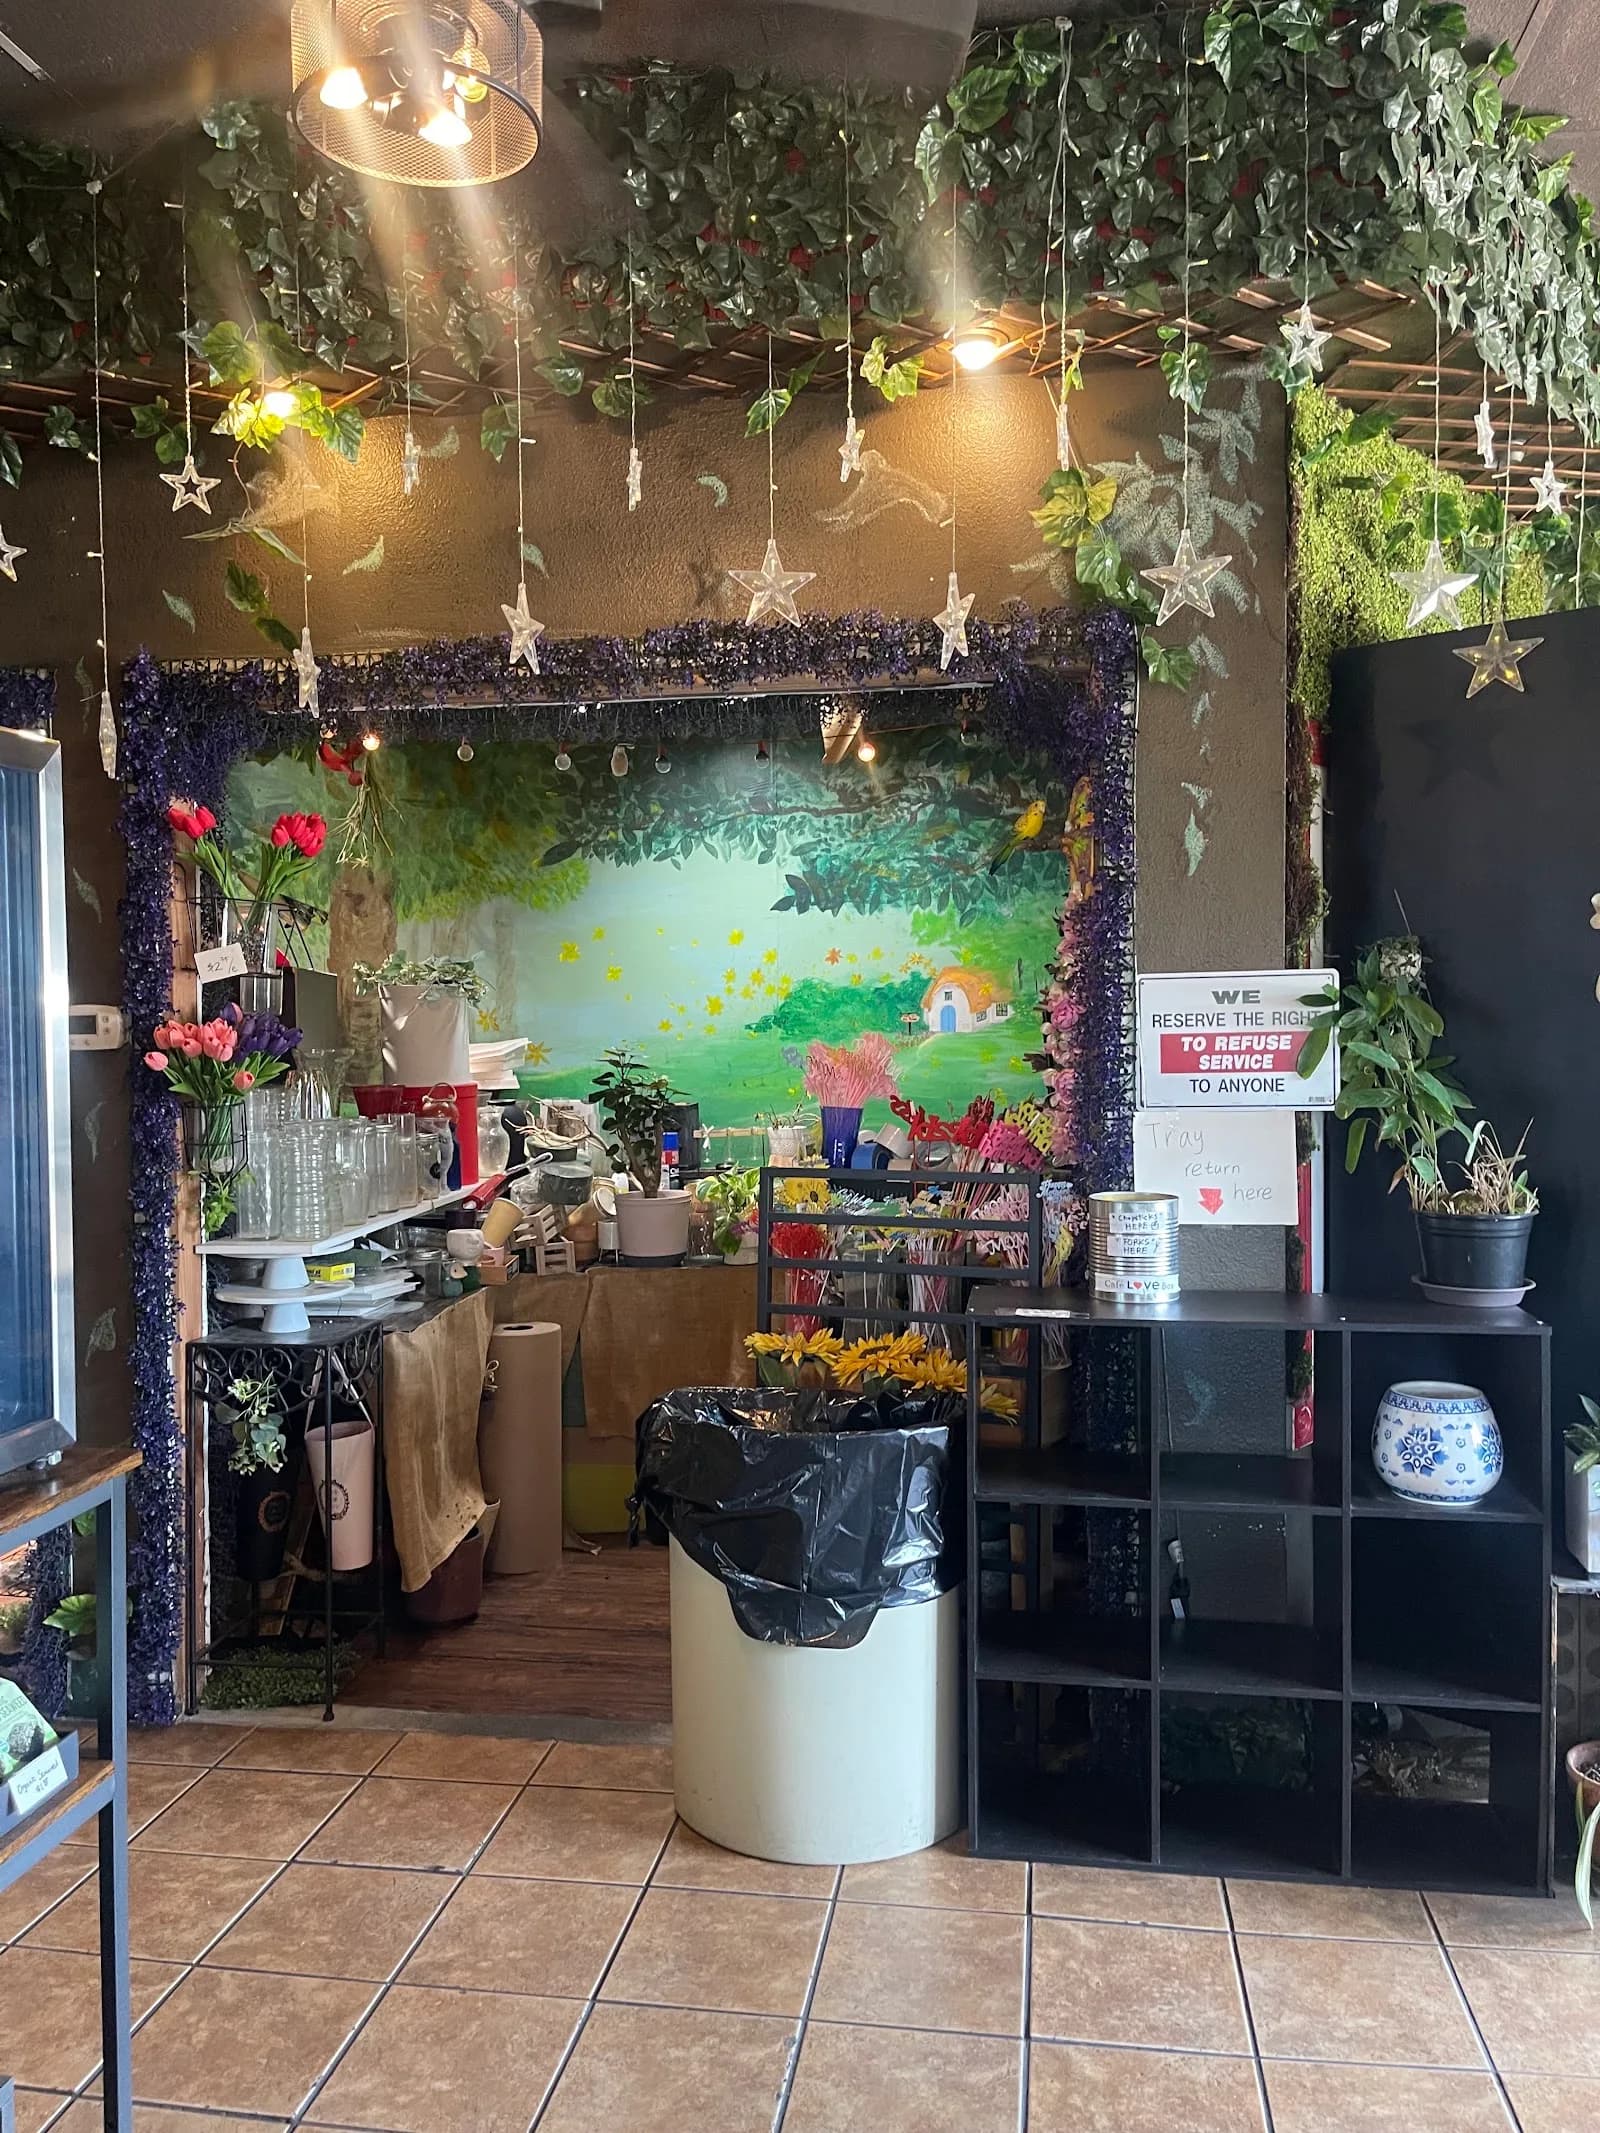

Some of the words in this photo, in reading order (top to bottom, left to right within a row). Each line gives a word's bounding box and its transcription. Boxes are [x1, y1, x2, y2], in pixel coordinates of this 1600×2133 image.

[1211, 990, 1261, 1005] WE
[1152, 1012, 1226, 1028] RESERVE
[1233, 1011, 1264, 1026] THE
[1180, 1036, 1207, 1052] TO
[1214, 1034, 1293, 1051] REFUSE
[1198, 1054, 1274, 1070] SERVICE
[1189, 1079, 1210, 1093] TO
[1218, 1078, 1285, 1093] ANYONE
[1144, 1122, 1204, 1154] Tray
[1184, 1161, 1241, 1177] return
[1232, 1183, 1273, 1200] here
[1123, 1247, 1148, 1255] HERE
